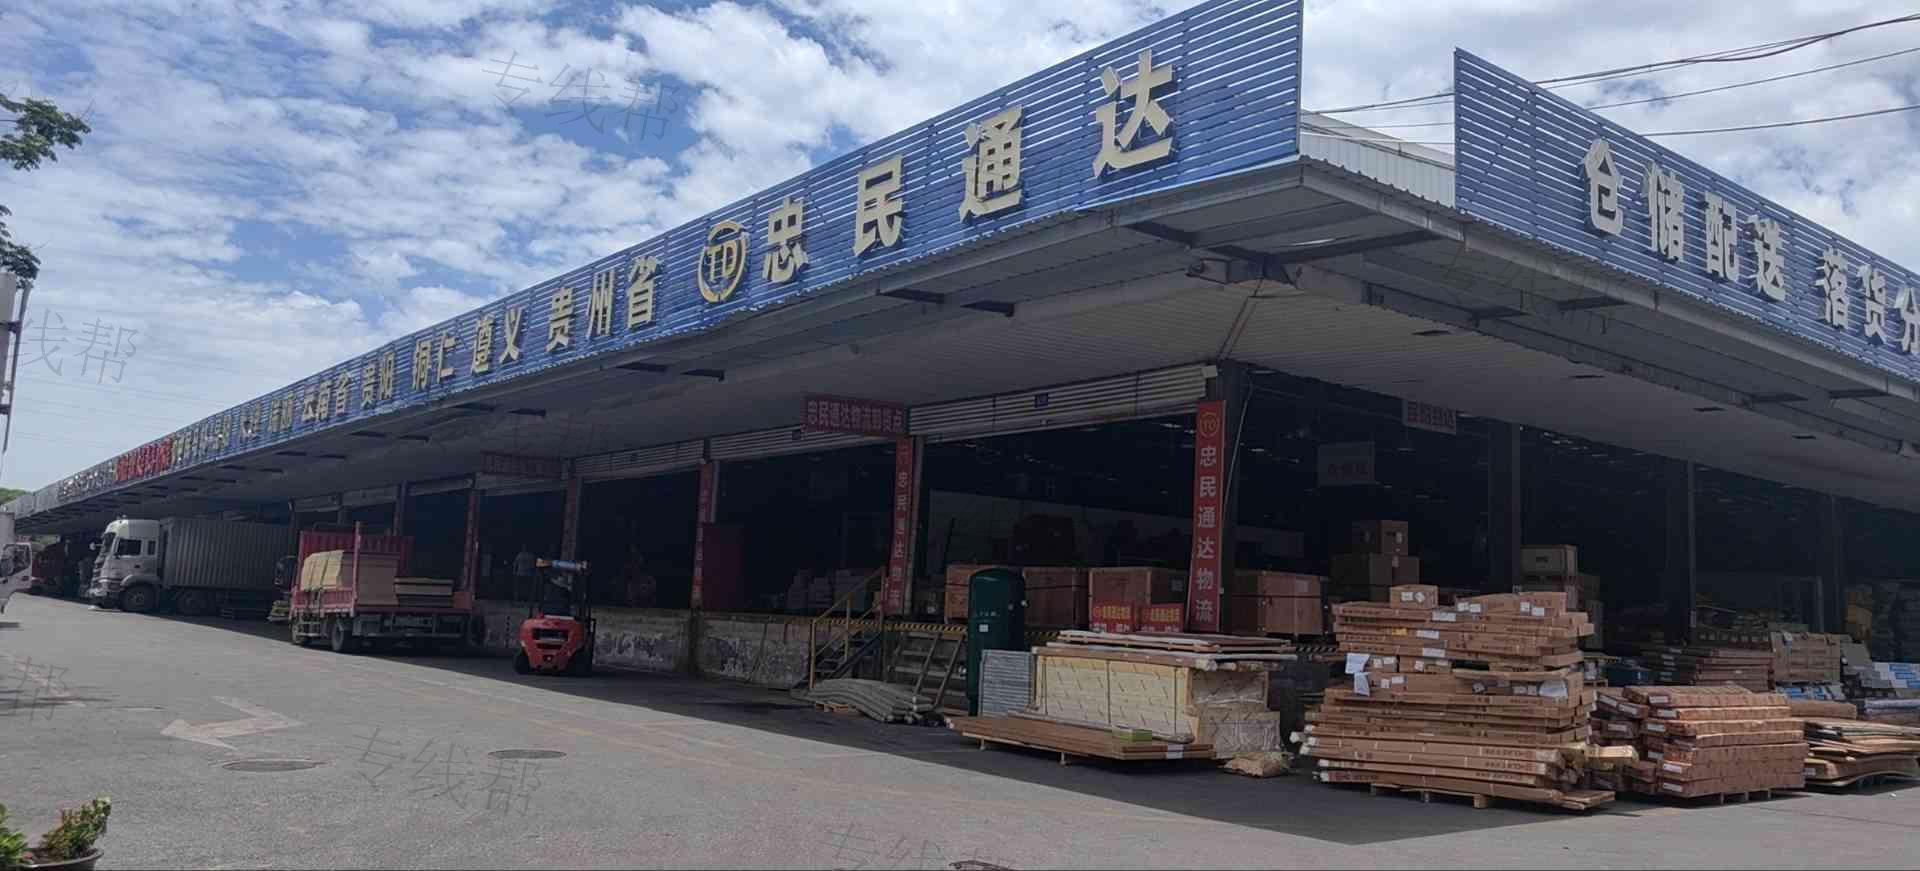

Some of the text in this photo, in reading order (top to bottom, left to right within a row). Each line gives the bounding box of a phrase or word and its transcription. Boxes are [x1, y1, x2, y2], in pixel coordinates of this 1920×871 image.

[762, 48, 1175, 284] 忠民通达
[1584, 137, 1787, 301] 仓储配送
[411, 331, 458, 391] 铜仁
[471, 307, 526, 374] 遵义
[546, 256, 659, 352] 贵州省
[1194, 446, 1218, 624] 忠民通达物流
